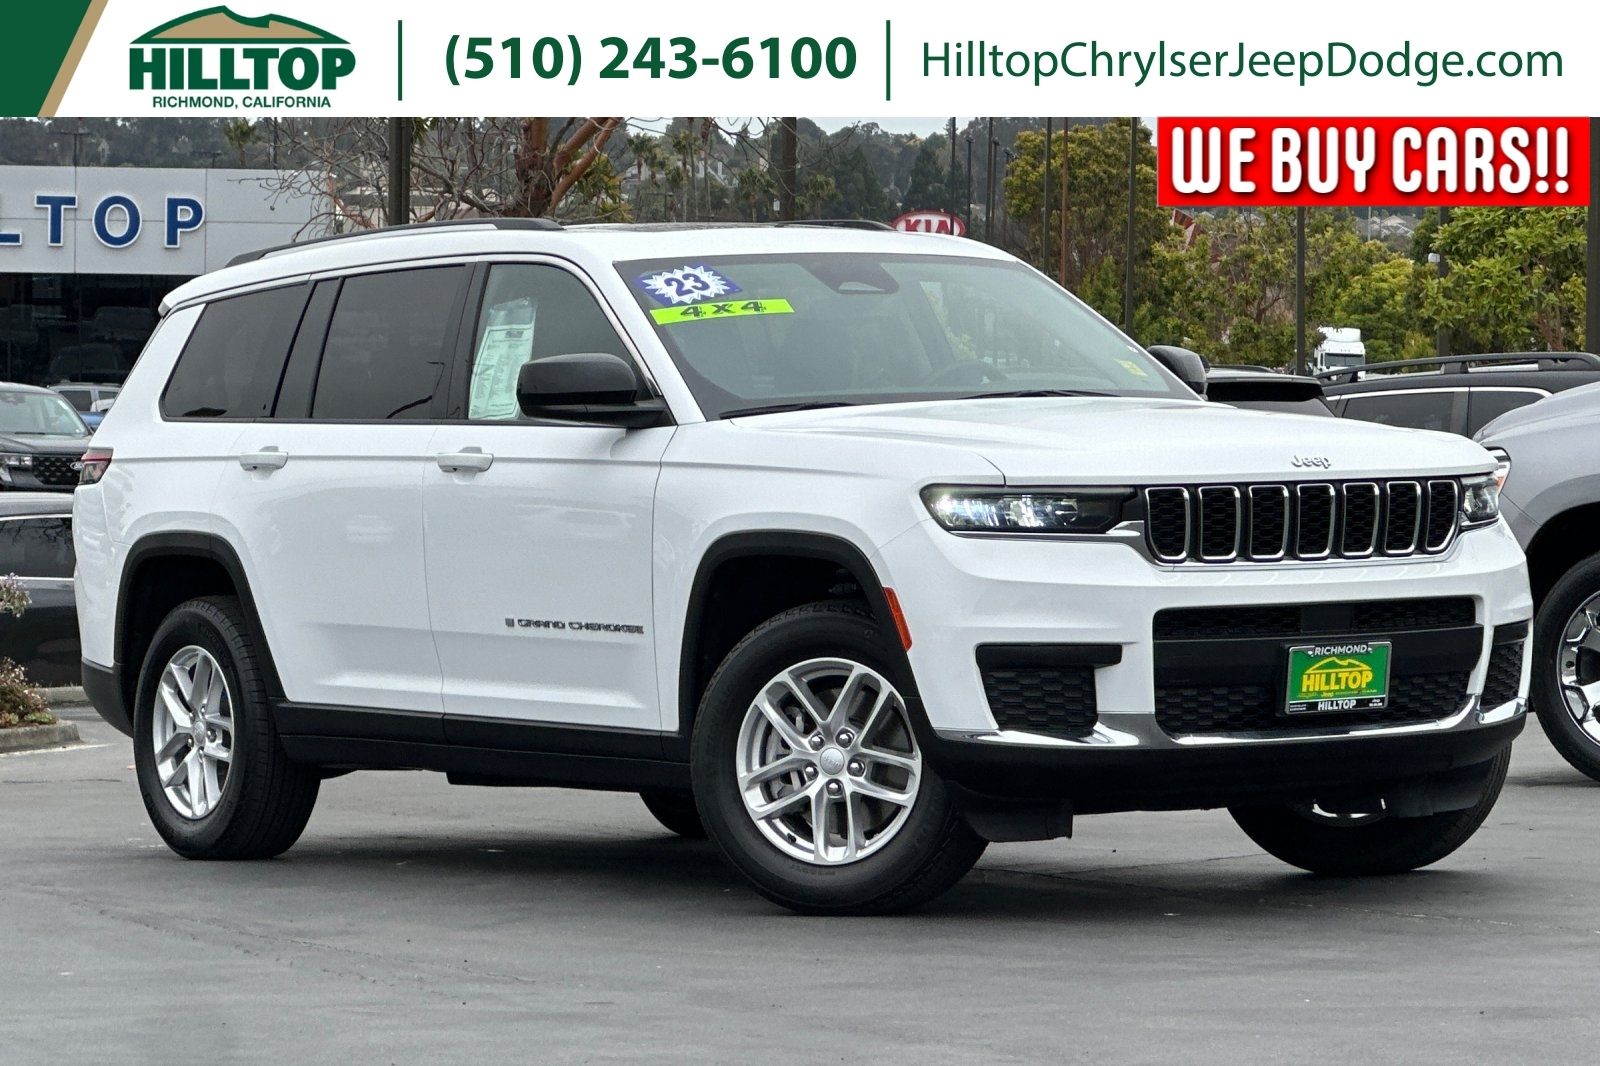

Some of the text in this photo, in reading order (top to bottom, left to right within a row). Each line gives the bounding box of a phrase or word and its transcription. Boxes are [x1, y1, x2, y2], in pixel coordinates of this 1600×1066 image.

[905, 219, 950, 235] KIA
[664, 273, 711, 297] 23
[1290, 454, 1331, 470] Jeep
[517, 618, 645, 635] GRAND CHEROKEE
[1314, 645, 1368, 656] RICHMOND
[1301, 670, 1373, 693] HILLTOP
[1317, 700, 1357, 711] HILLTOP
